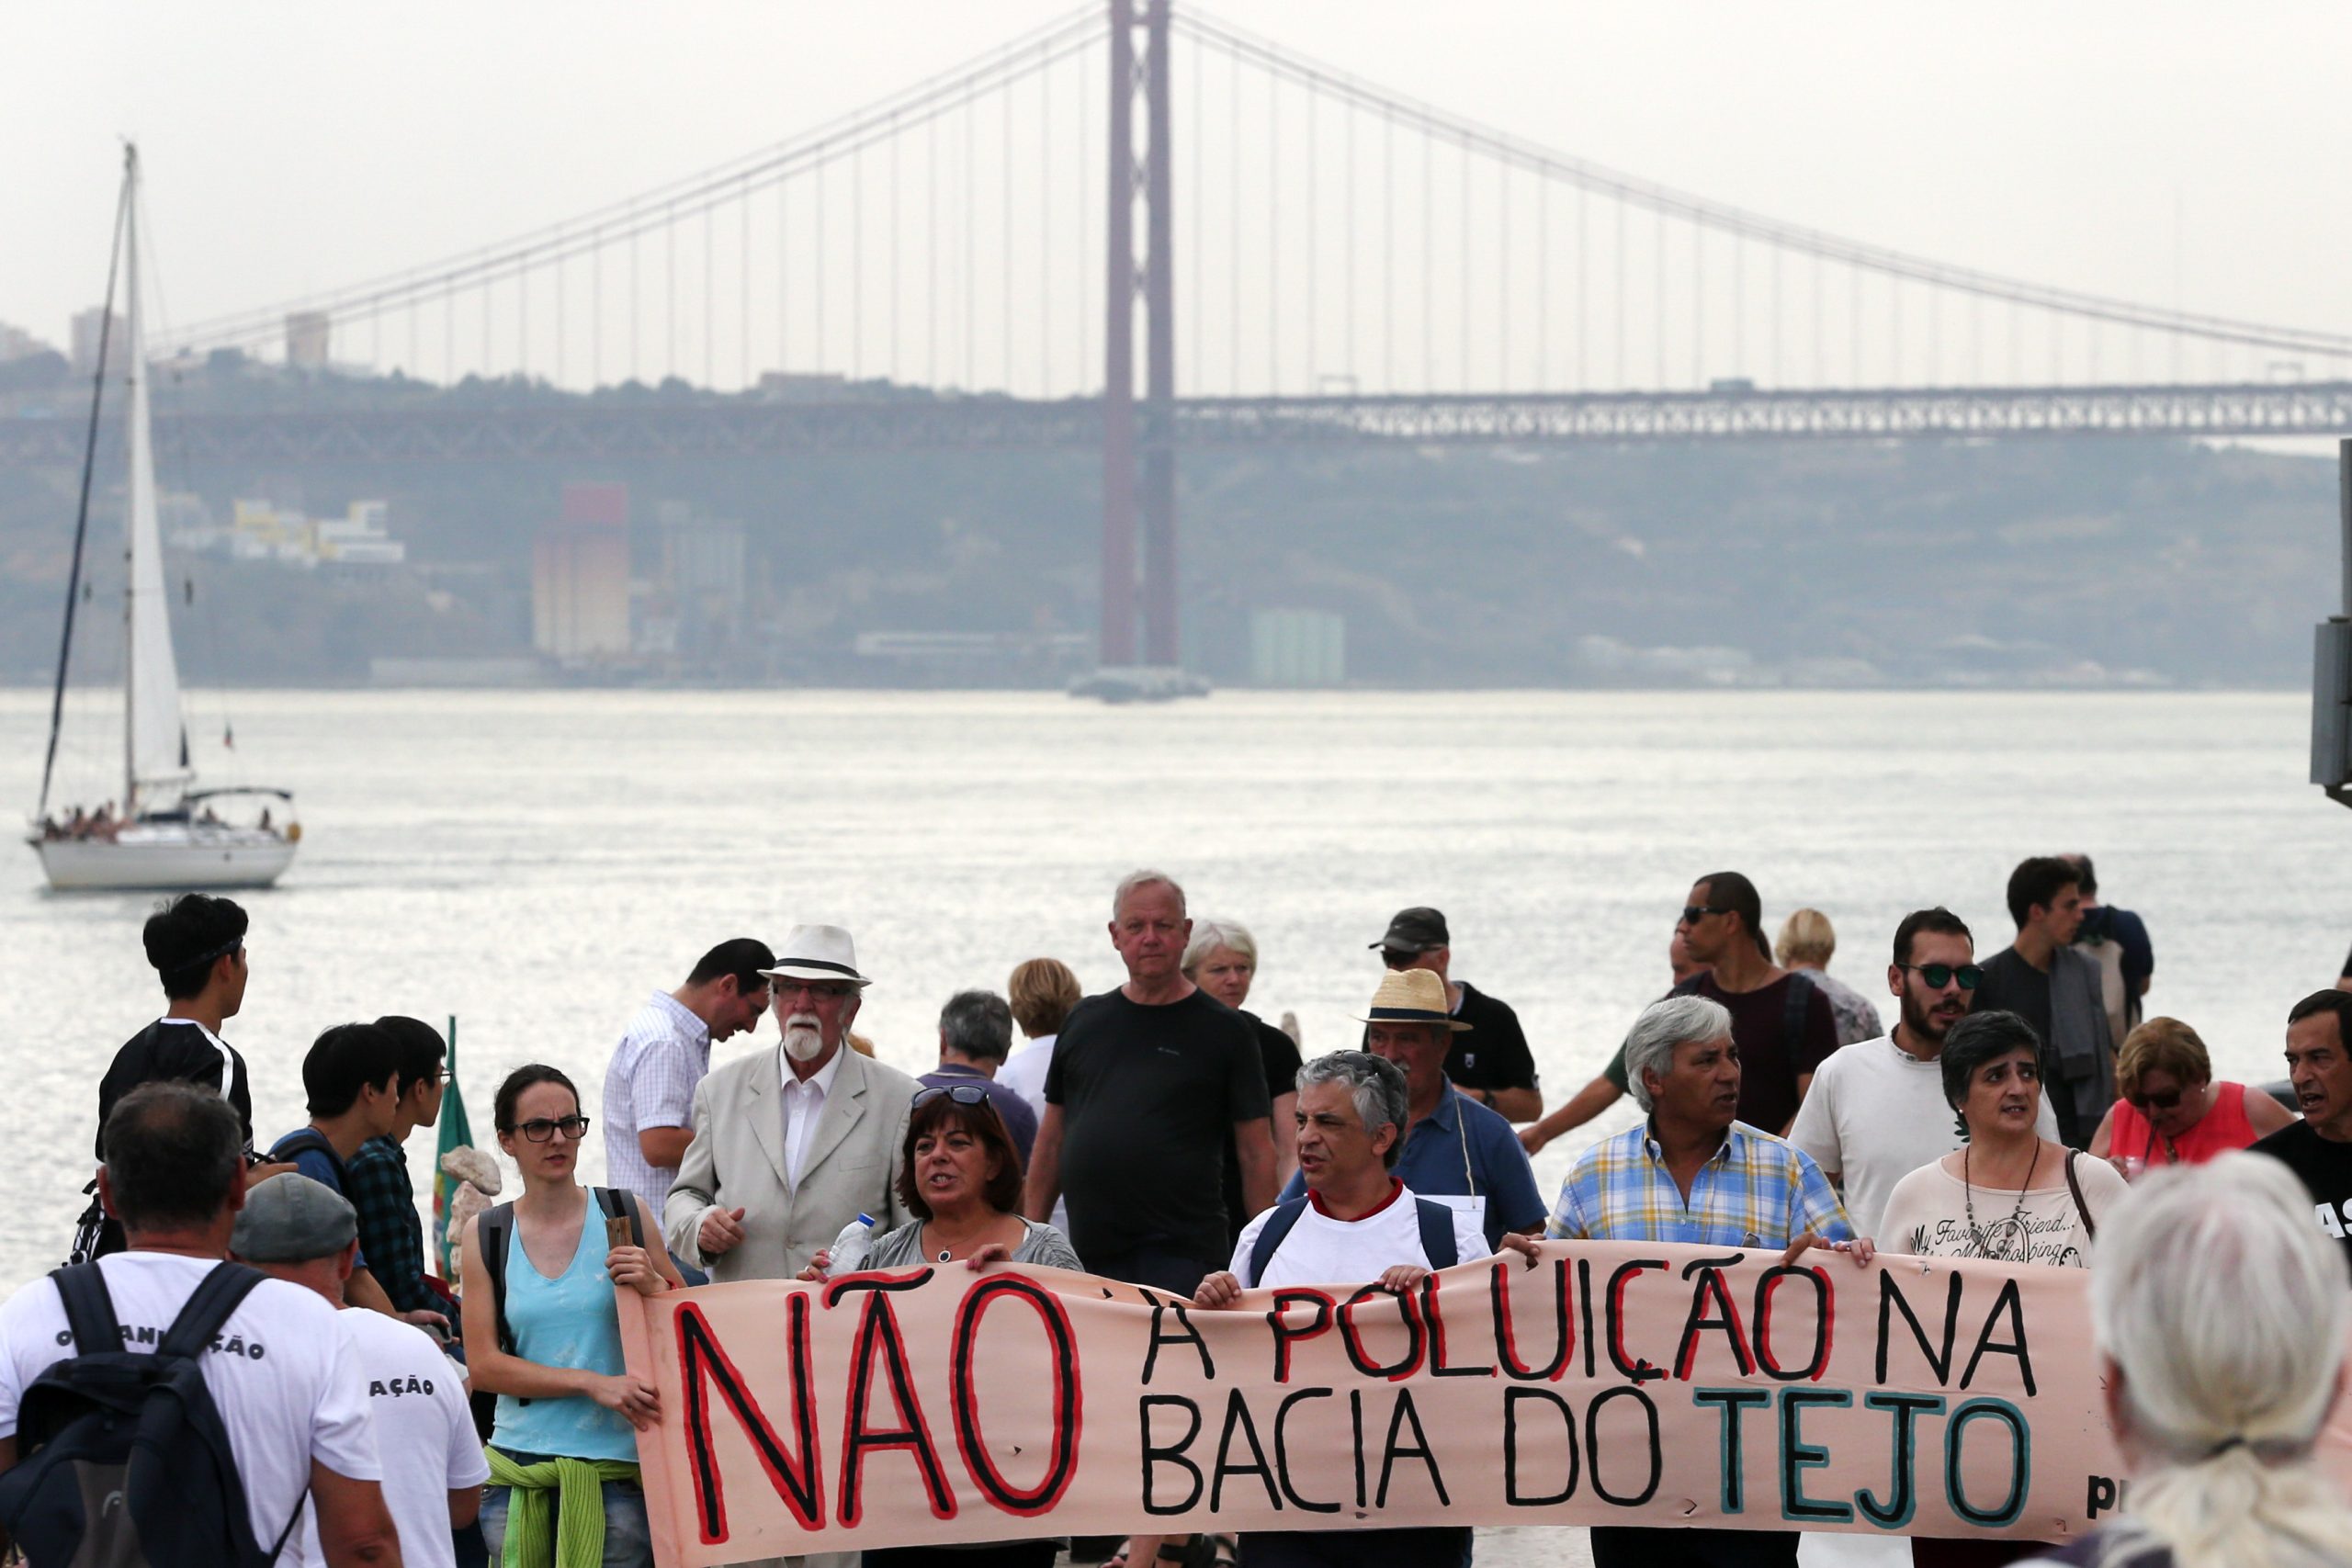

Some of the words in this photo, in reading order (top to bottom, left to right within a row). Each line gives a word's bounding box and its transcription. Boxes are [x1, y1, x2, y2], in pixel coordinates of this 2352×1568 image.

[1911, 1224, 1931, 1256] My
[1934, 1219, 2003, 1246] Favorite
[1267, 1252, 1835, 1386] POLUIÇÃO
[1875, 1269, 2037, 1397] NA
[674, 1267, 1083, 1545] NÃO
[1139, 1387, 1451, 1516] BACIA
[1503, 1384, 1663, 1507] DO
[1691, 1385, 2031, 1529] TEJO
